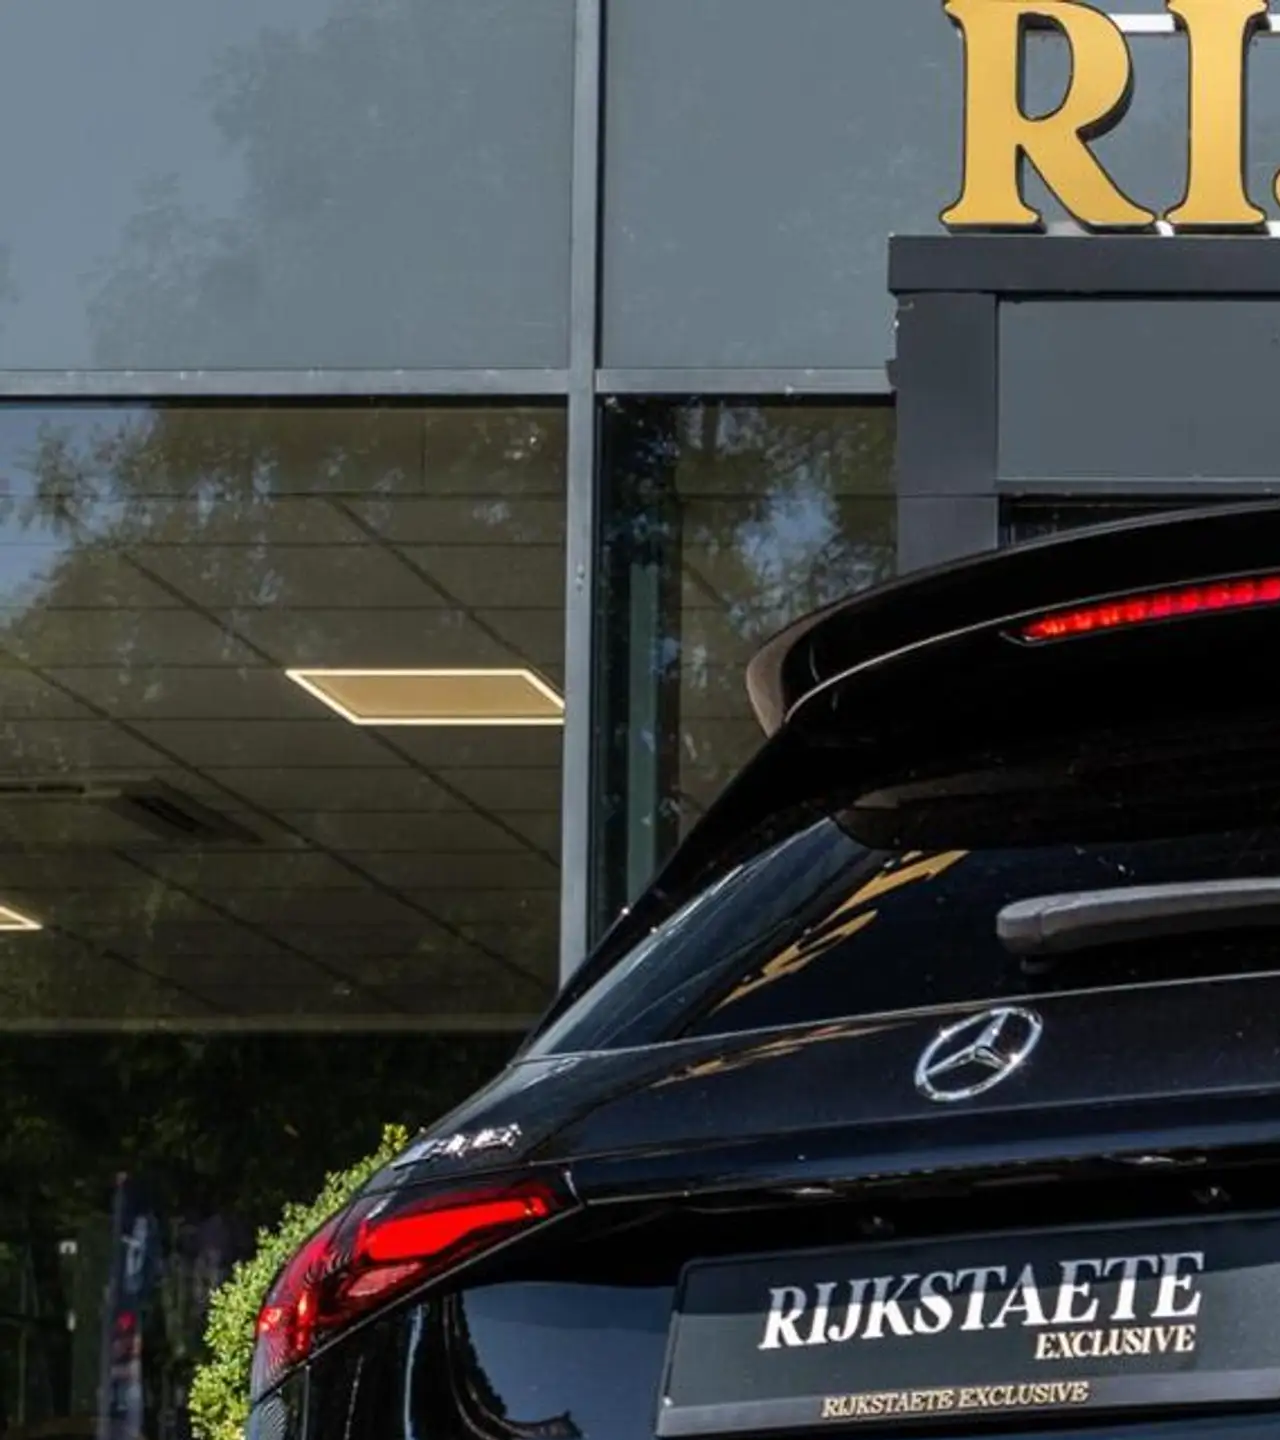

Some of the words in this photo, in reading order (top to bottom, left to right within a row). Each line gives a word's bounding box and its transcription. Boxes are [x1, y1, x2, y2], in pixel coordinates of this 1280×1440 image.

[758, 1251, 1204, 1349] RIJKSTAETE
[1034, 1324, 1196, 1360] EXCLUSIVE
[820, 1389, 953, 1418] RIJKSTAETE
[957, 1381, 1089, 1408] EXCLUSIVE
